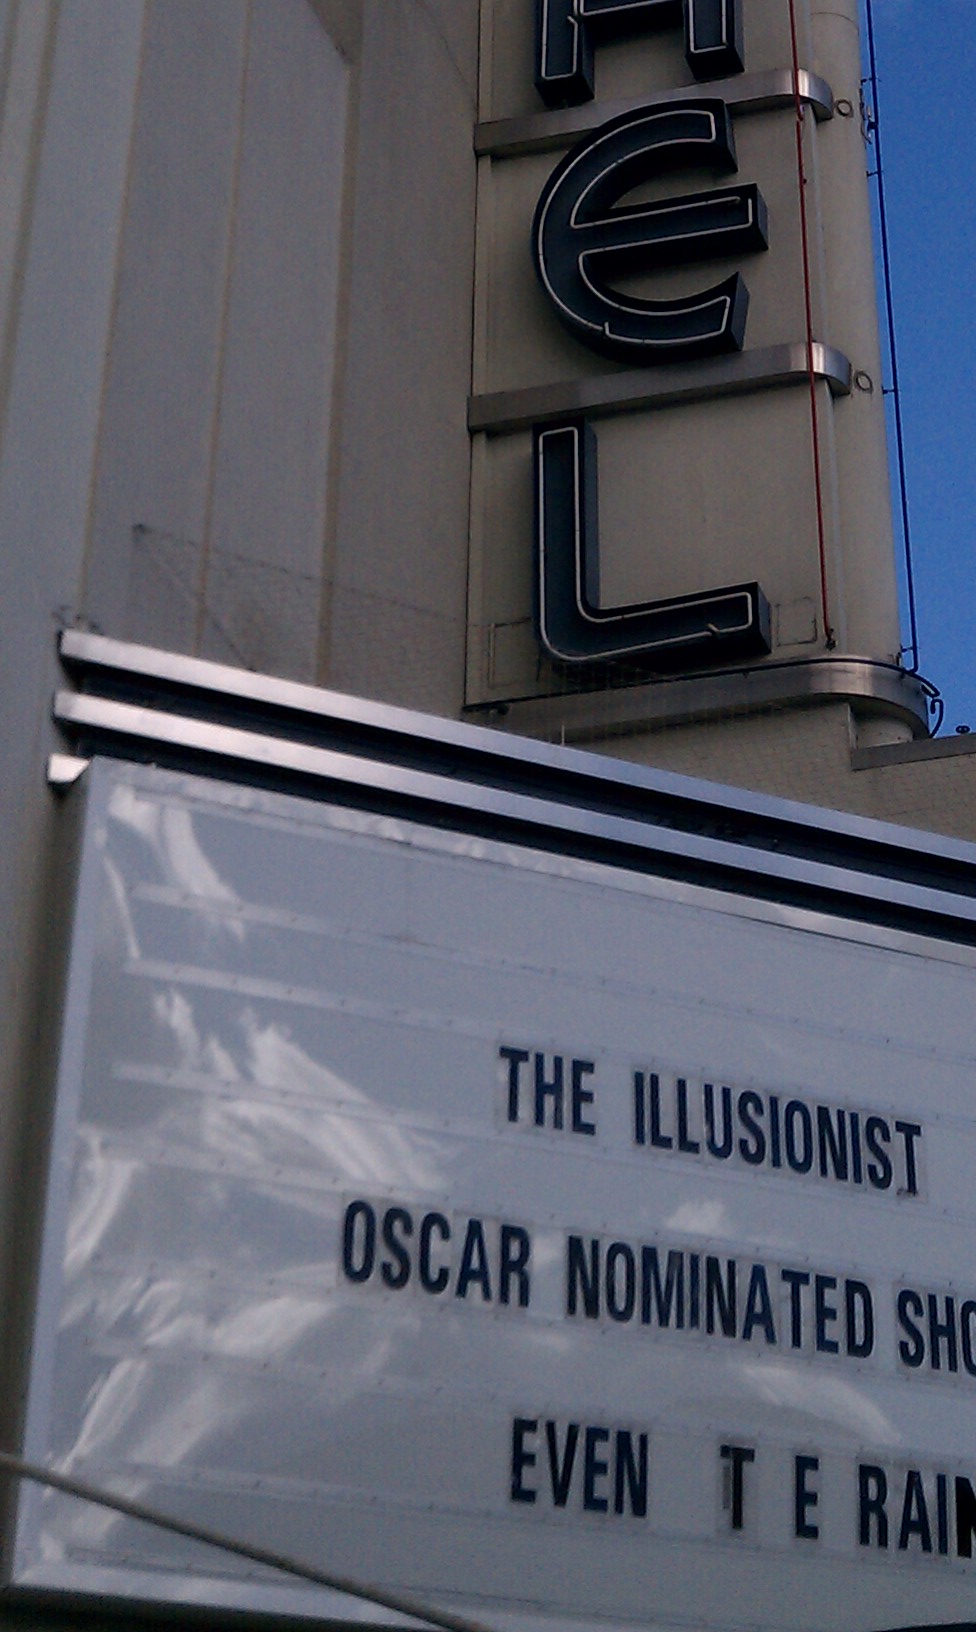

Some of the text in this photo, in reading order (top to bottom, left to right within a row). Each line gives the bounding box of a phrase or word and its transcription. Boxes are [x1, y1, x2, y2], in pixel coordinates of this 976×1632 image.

[499, 1046, 923, 1195] THE ILLUSIONIST
[341, 1199, 531, 1306] OSCAR
[565, 1235, 875, 1359] NOMINATED
[510, 1417, 649, 1517] EVEN
